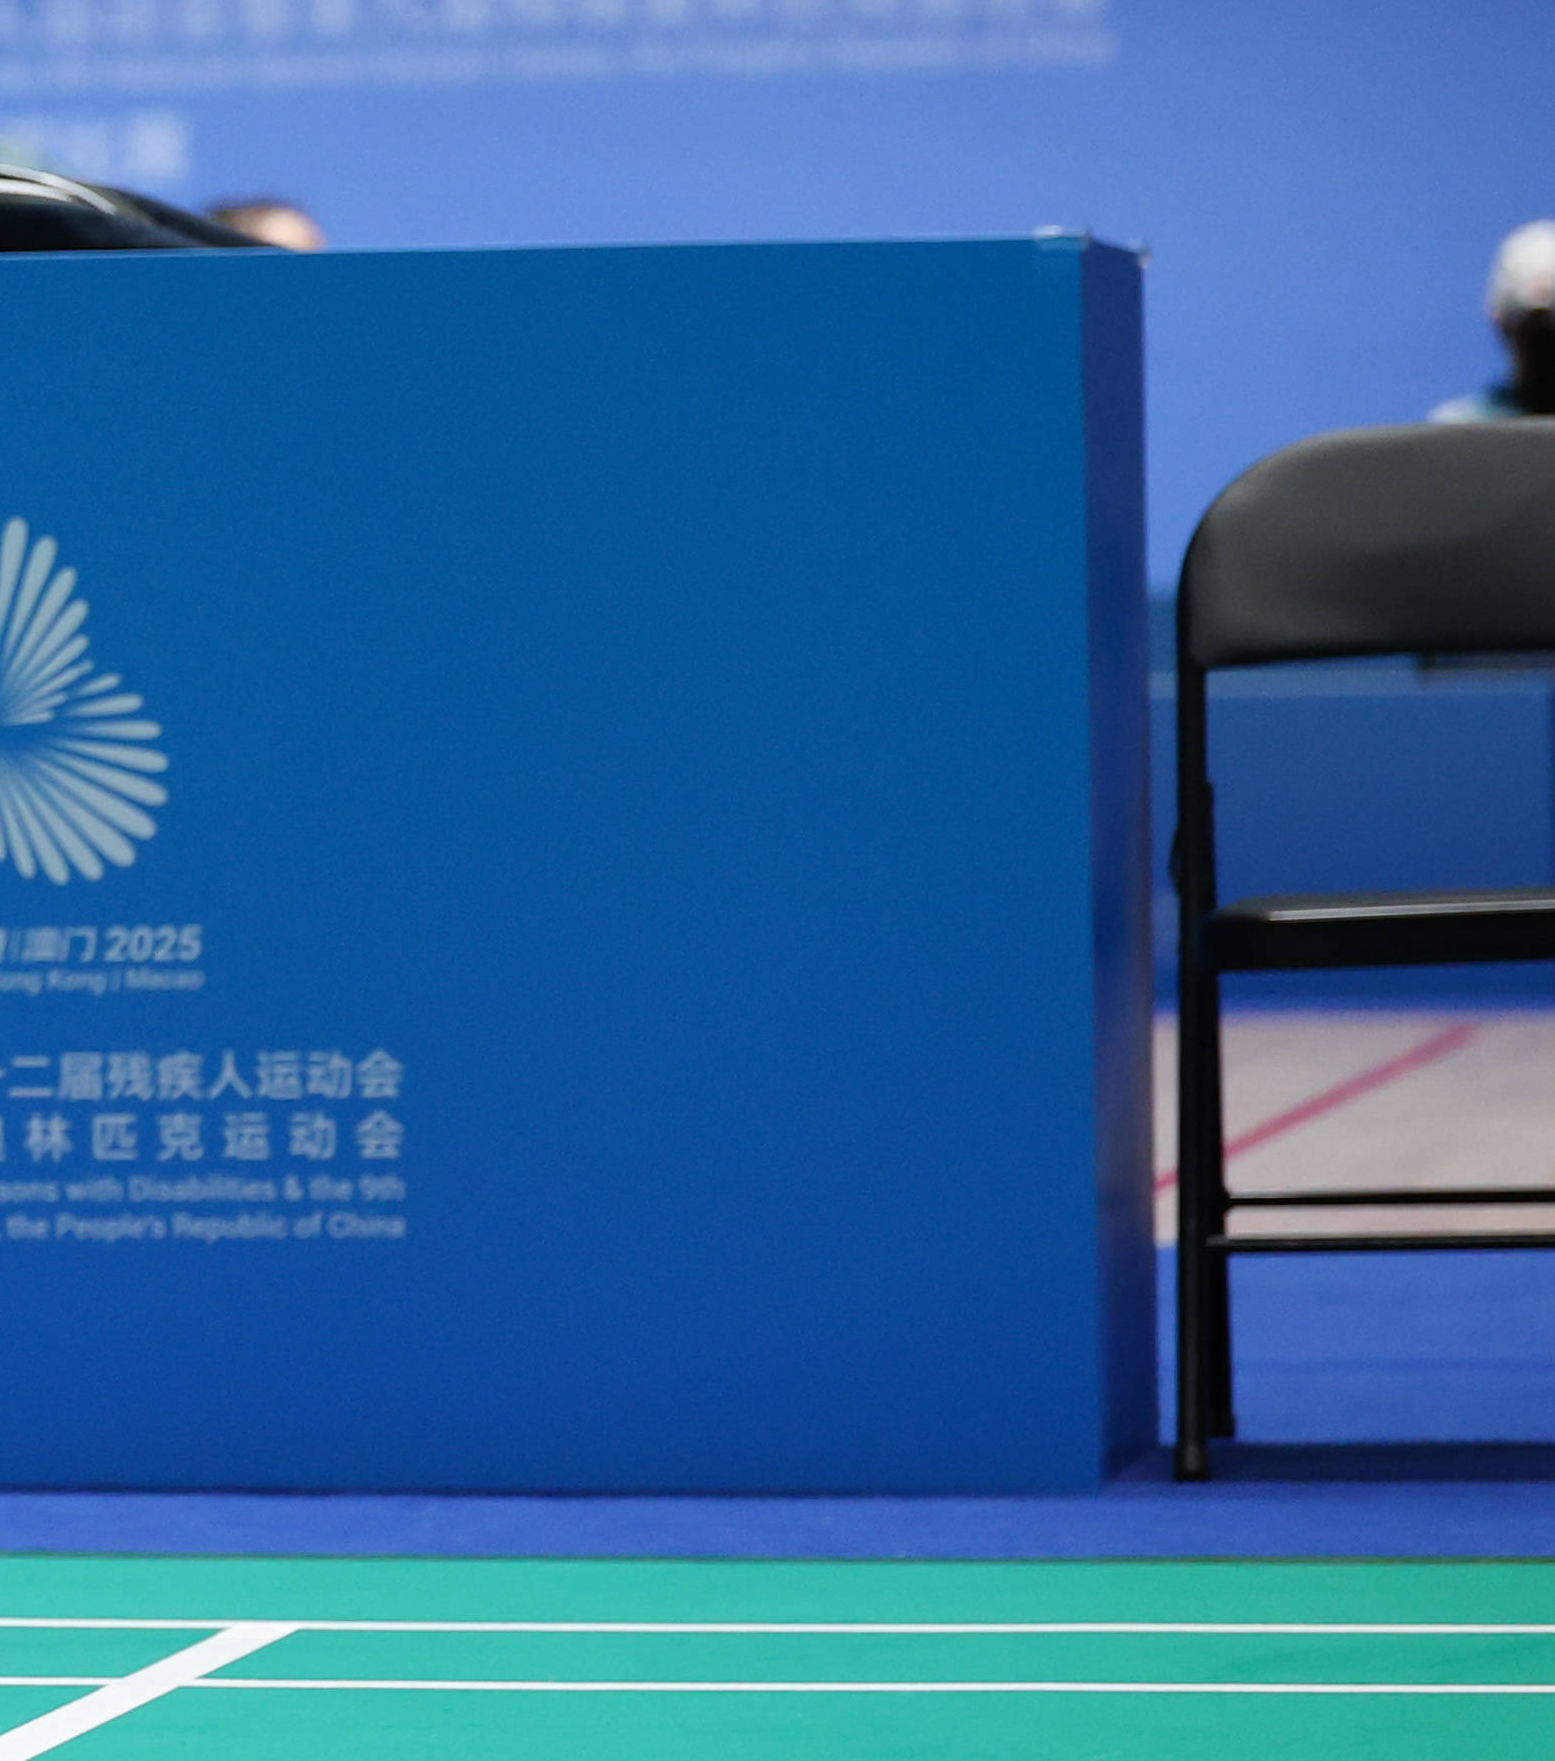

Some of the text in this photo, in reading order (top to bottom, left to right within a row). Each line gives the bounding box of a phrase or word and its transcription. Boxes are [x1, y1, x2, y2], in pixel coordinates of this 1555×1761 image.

[104, 925, 202, 962] 2025
[309, 1174, 354, 1201] the
[6, 1213, 50, 1239] the
[293, 1211, 324, 1238] of
